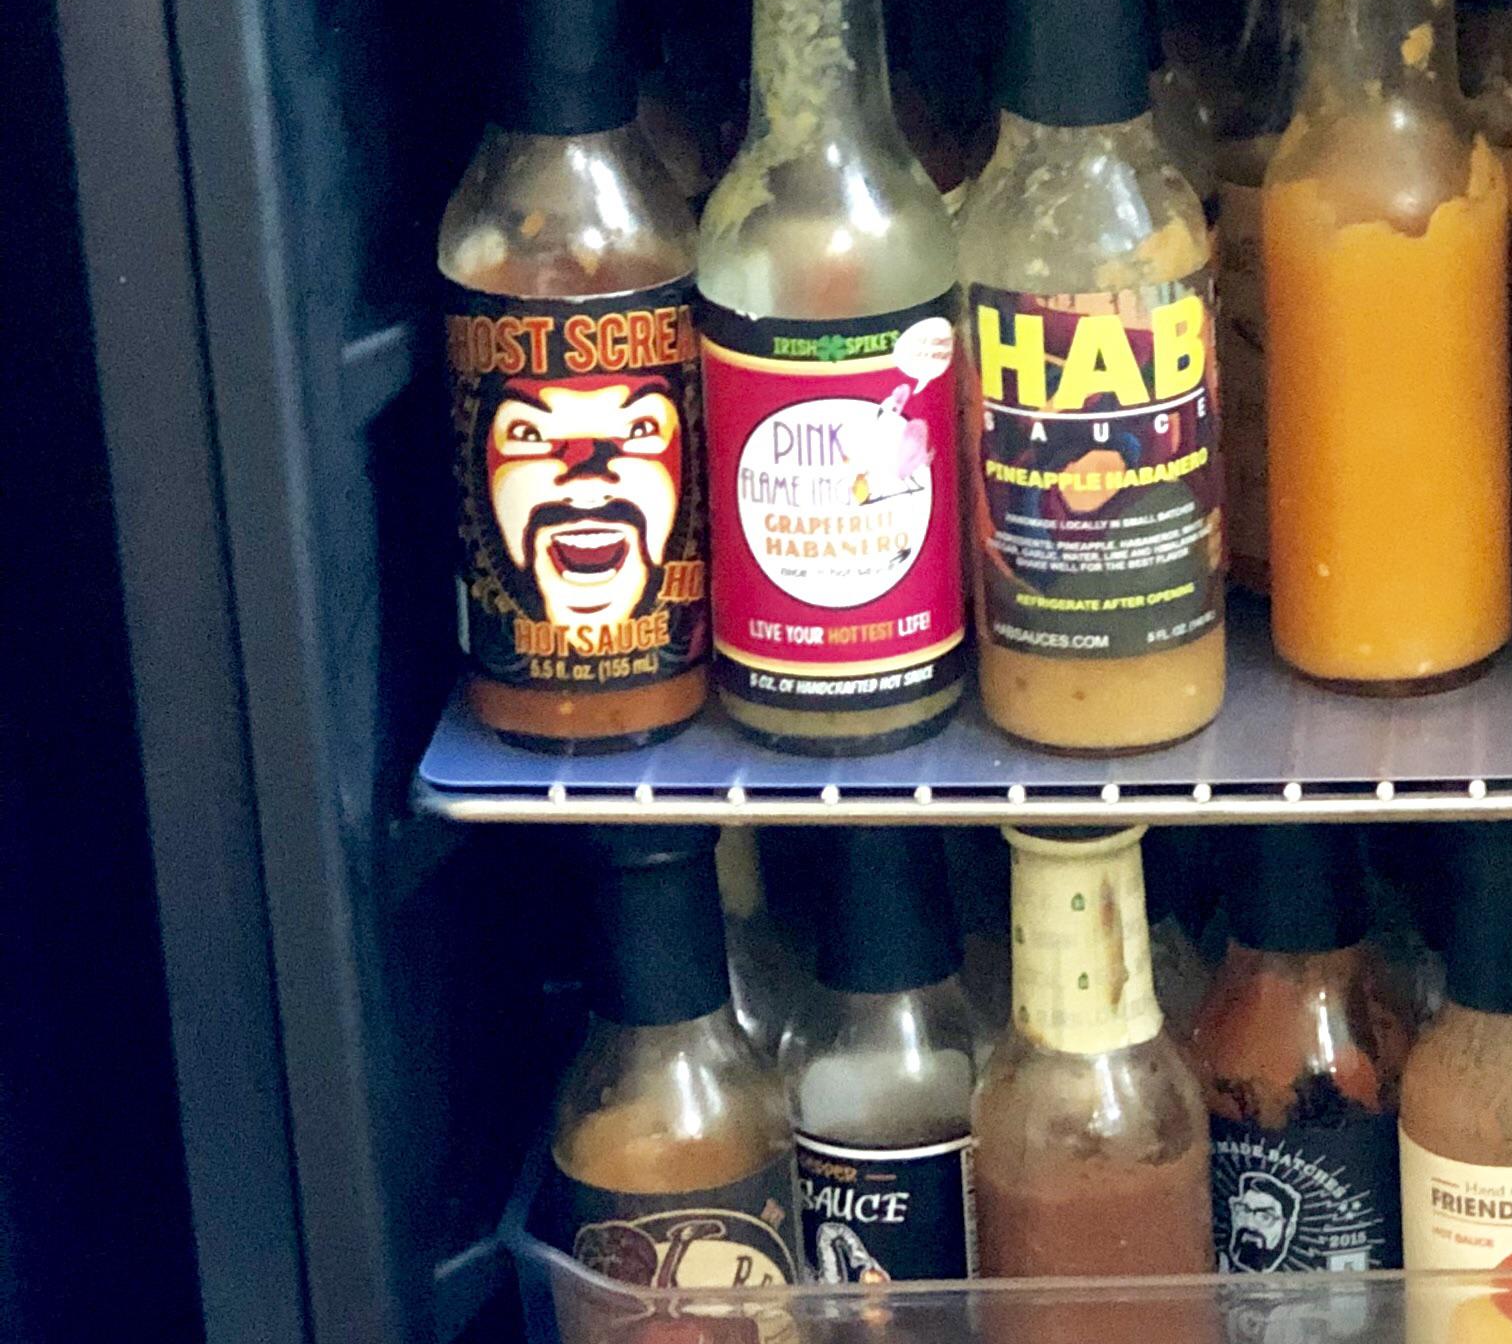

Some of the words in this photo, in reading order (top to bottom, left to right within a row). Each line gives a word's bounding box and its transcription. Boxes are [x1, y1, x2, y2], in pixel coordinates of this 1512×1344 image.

[773, 337, 817, 357] IRISH
[845, 330, 899, 355] SPIKE'S
[976, 294, 1207, 411] HAB
[772, 420, 850, 467] PINK
[984, 458, 1102, 493] PINEAPPLE
[1104, 447, 1209, 491] HABANERO
[1102, 594, 1145, 610] AFTER
[513, 623, 571, 656] HOT
[576, 612, 670, 657] SAUCE
[749, 618, 782, 642] LIVE
[786, 624, 825, 645] YOUR
[828, 620, 895, 645] HOTTEST
[898, 611, 932, 637] LIFE!
[1465, 1180, 1506, 1197] Hand
[1454, 1232, 1494, 1248] SAUCE
